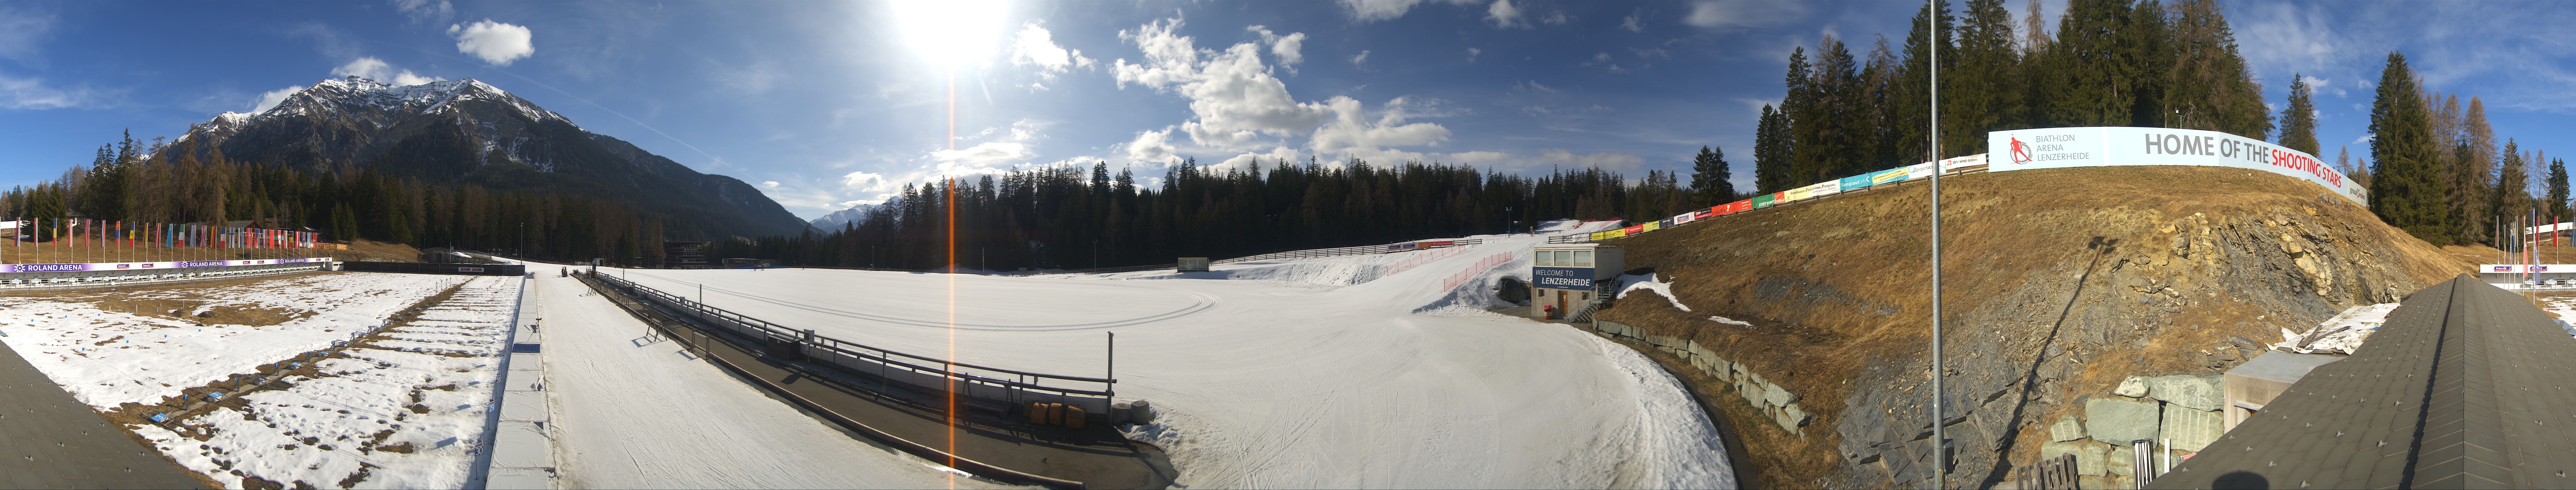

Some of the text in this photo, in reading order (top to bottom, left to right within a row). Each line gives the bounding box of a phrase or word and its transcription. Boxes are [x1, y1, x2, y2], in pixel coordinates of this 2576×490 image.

[2038, 153, 2089, 161] LENZERHEIDE
[2146, 134, 2341, 188] HOME OF THE SHOOTING STARS
[1759, 198, 1784, 207] parpanbau
[1541, 277, 1590, 286] LENZERHEIDE
[476, 446, 483, 455] 30
